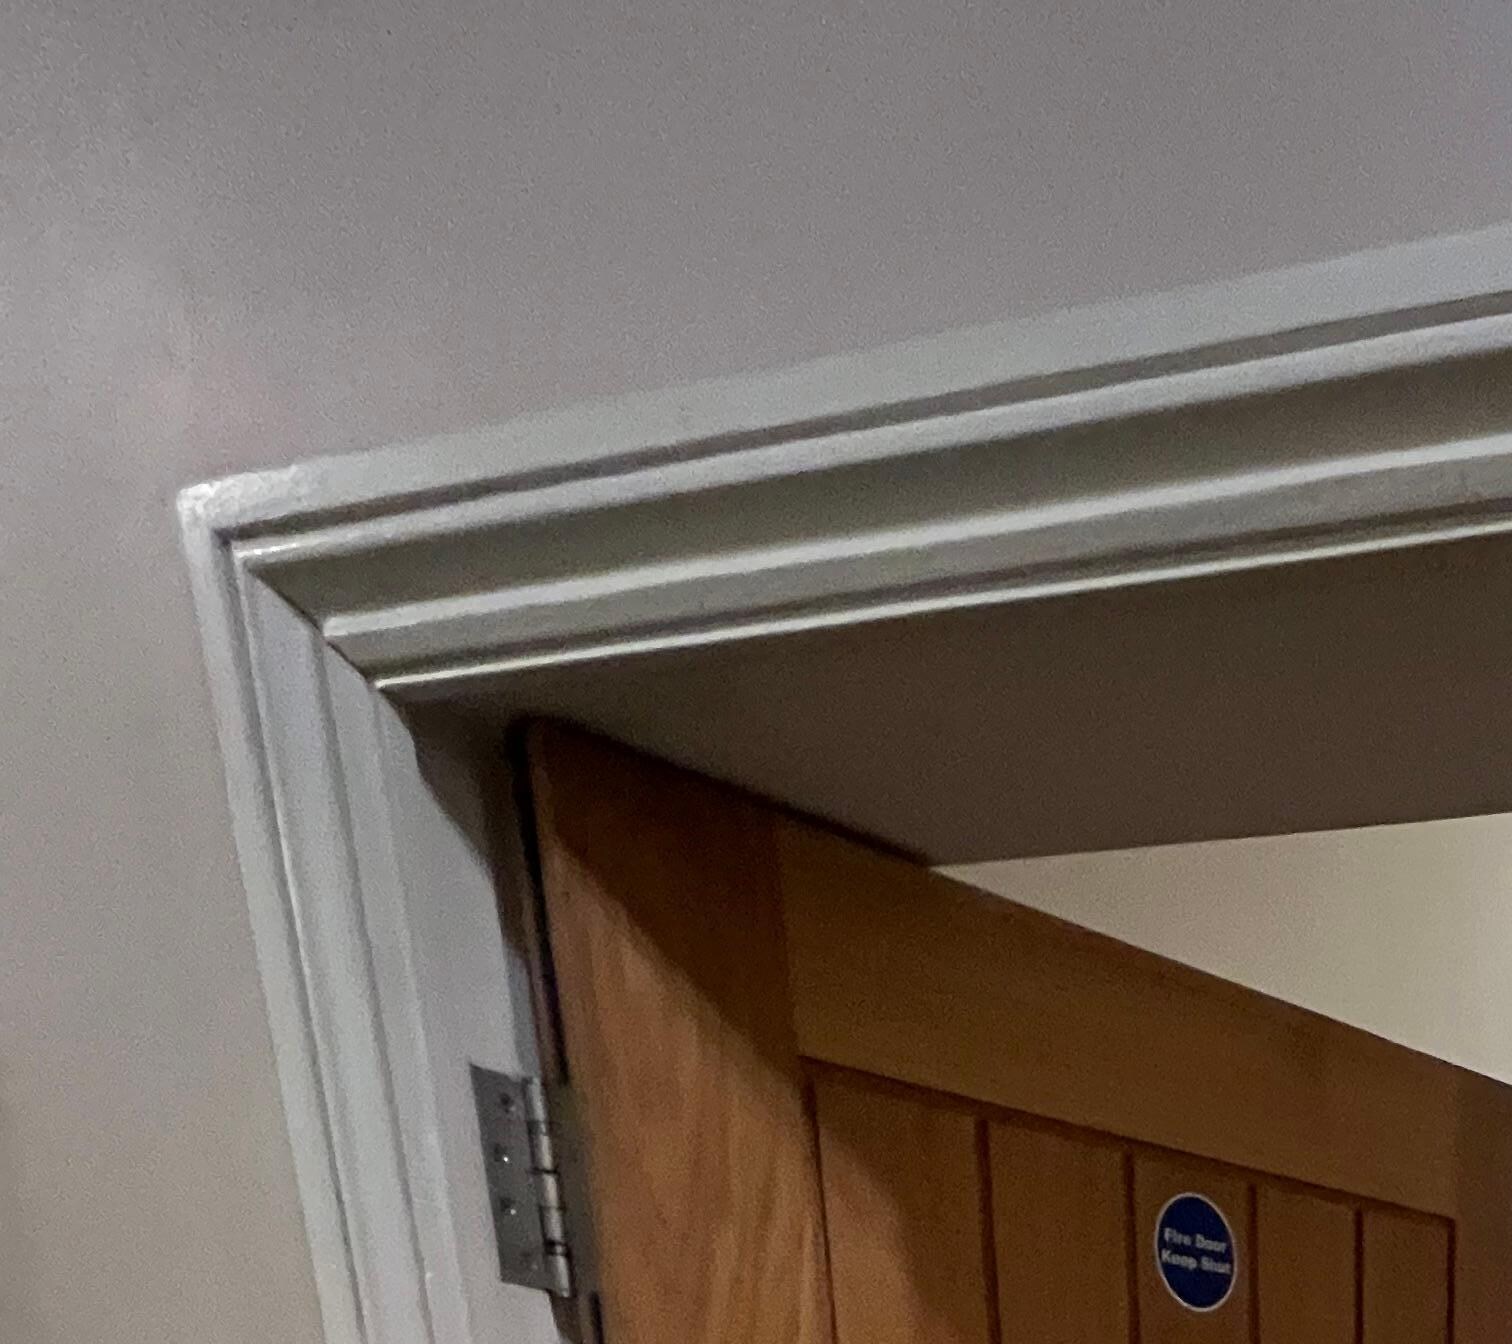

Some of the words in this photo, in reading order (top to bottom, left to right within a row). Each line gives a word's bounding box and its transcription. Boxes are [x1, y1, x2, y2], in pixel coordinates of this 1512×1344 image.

[1164, 1227, 1192, 1246] Fire
[1195, 1233, 1227, 1253] Door
[1161, 1248, 1198, 1270] Keep
[1200, 1255, 1231, 1274] Shut
